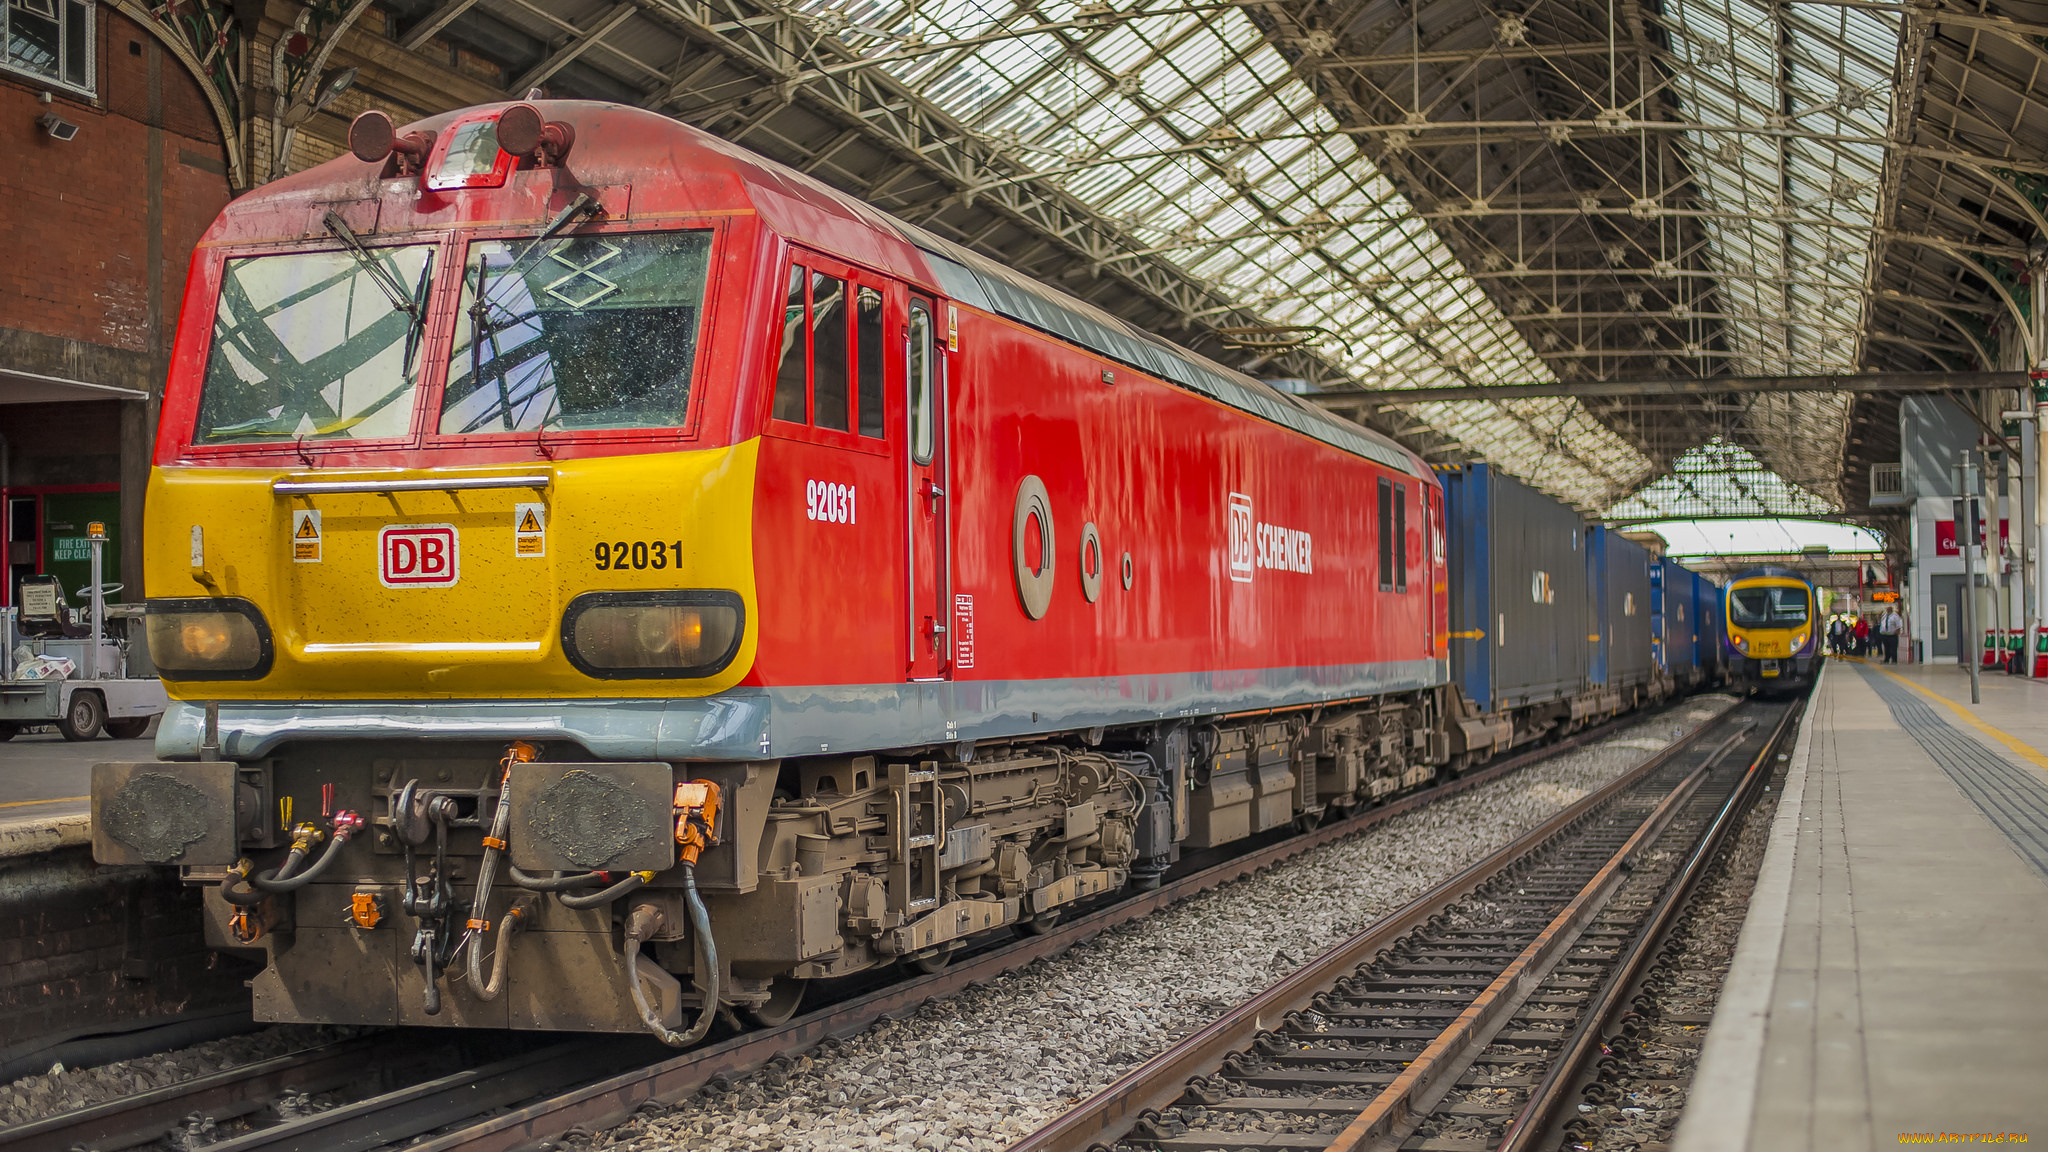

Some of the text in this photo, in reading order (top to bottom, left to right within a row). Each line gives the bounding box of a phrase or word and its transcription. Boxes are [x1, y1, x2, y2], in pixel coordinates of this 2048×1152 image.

[807, 479, 856, 525] 92031
[54, 549, 92, 560] KEEP CLEA
[59, 539, 91, 549] FIRE EXIT
[392, 537, 446, 575] DB
[594, 540, 683, 571] 92031
[1232, 508, 1313, 575] DB SCHENKER
